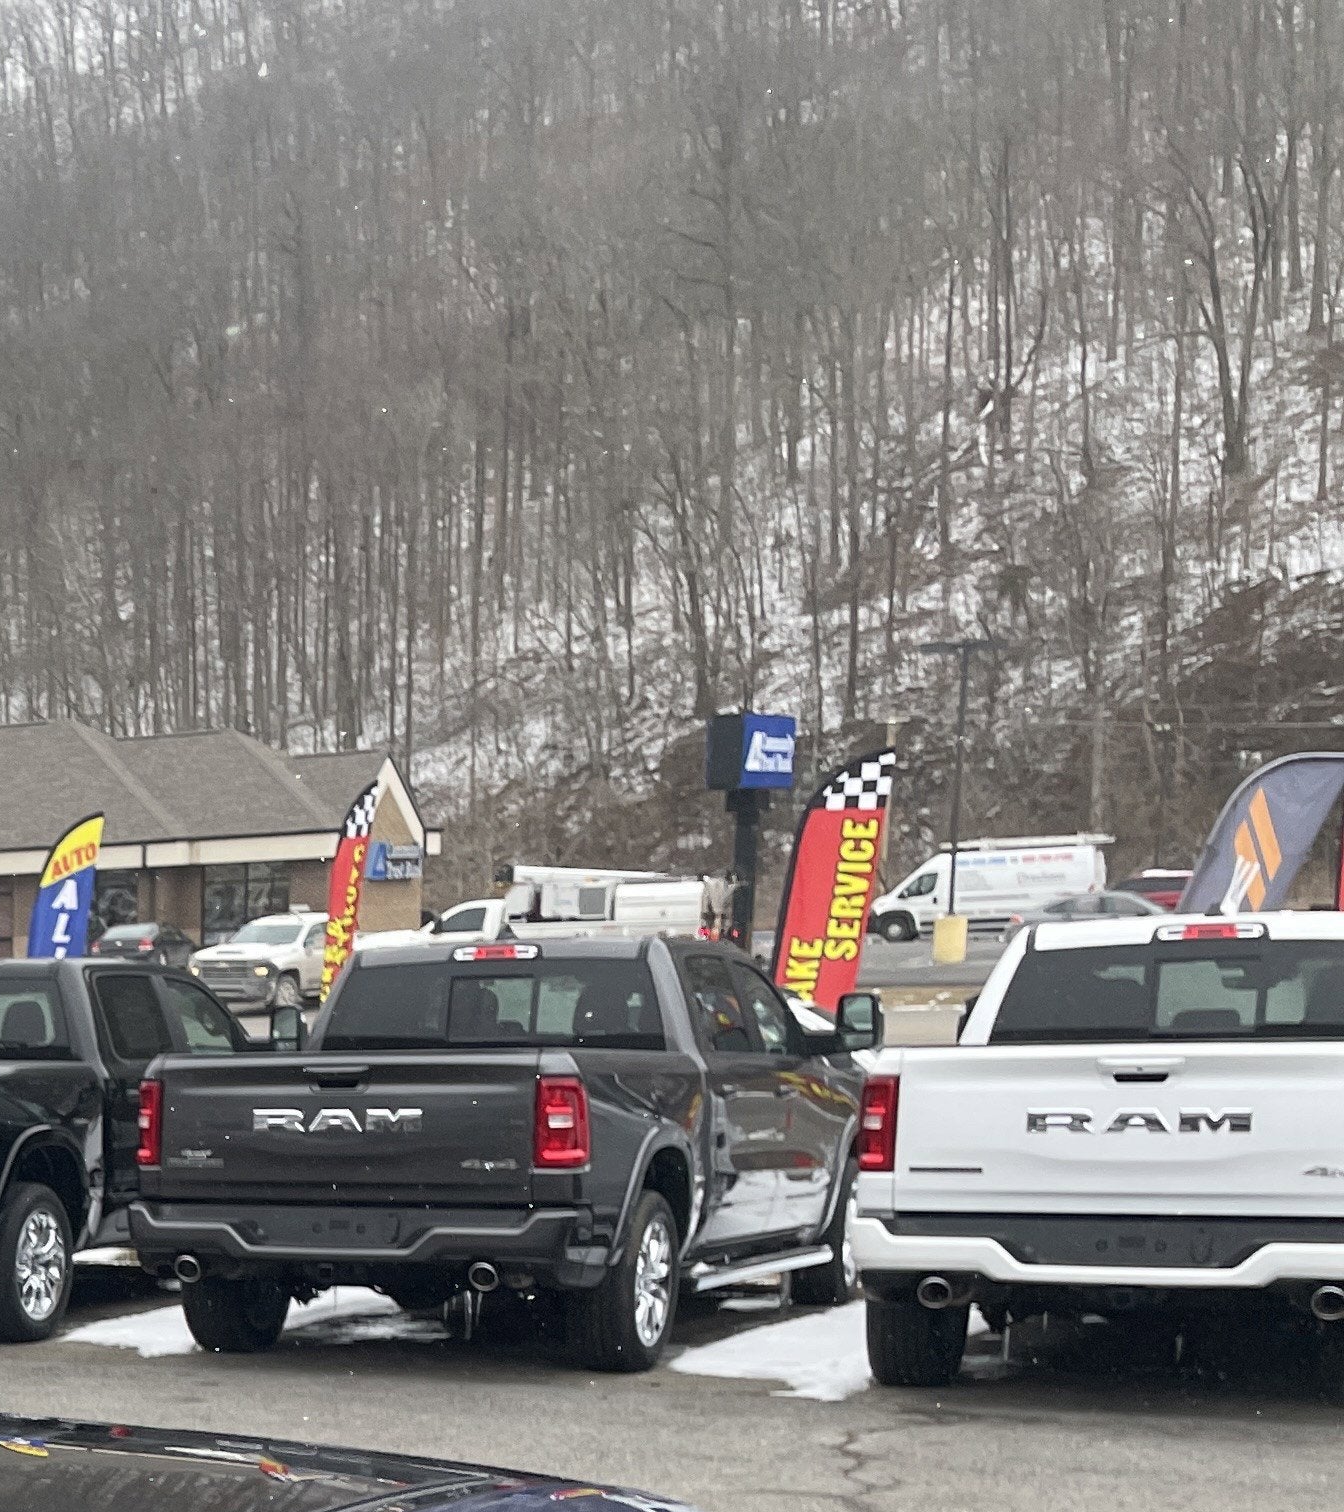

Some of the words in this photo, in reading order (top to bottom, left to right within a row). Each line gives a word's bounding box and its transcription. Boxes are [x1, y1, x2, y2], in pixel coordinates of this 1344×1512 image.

[51, 842, 97, 880] AUTO
[823, 818, 881, 962] SERVICE
[252, 1108, 423, 1132] RAM
[1026, 1107, 1254, 1134] RAM
